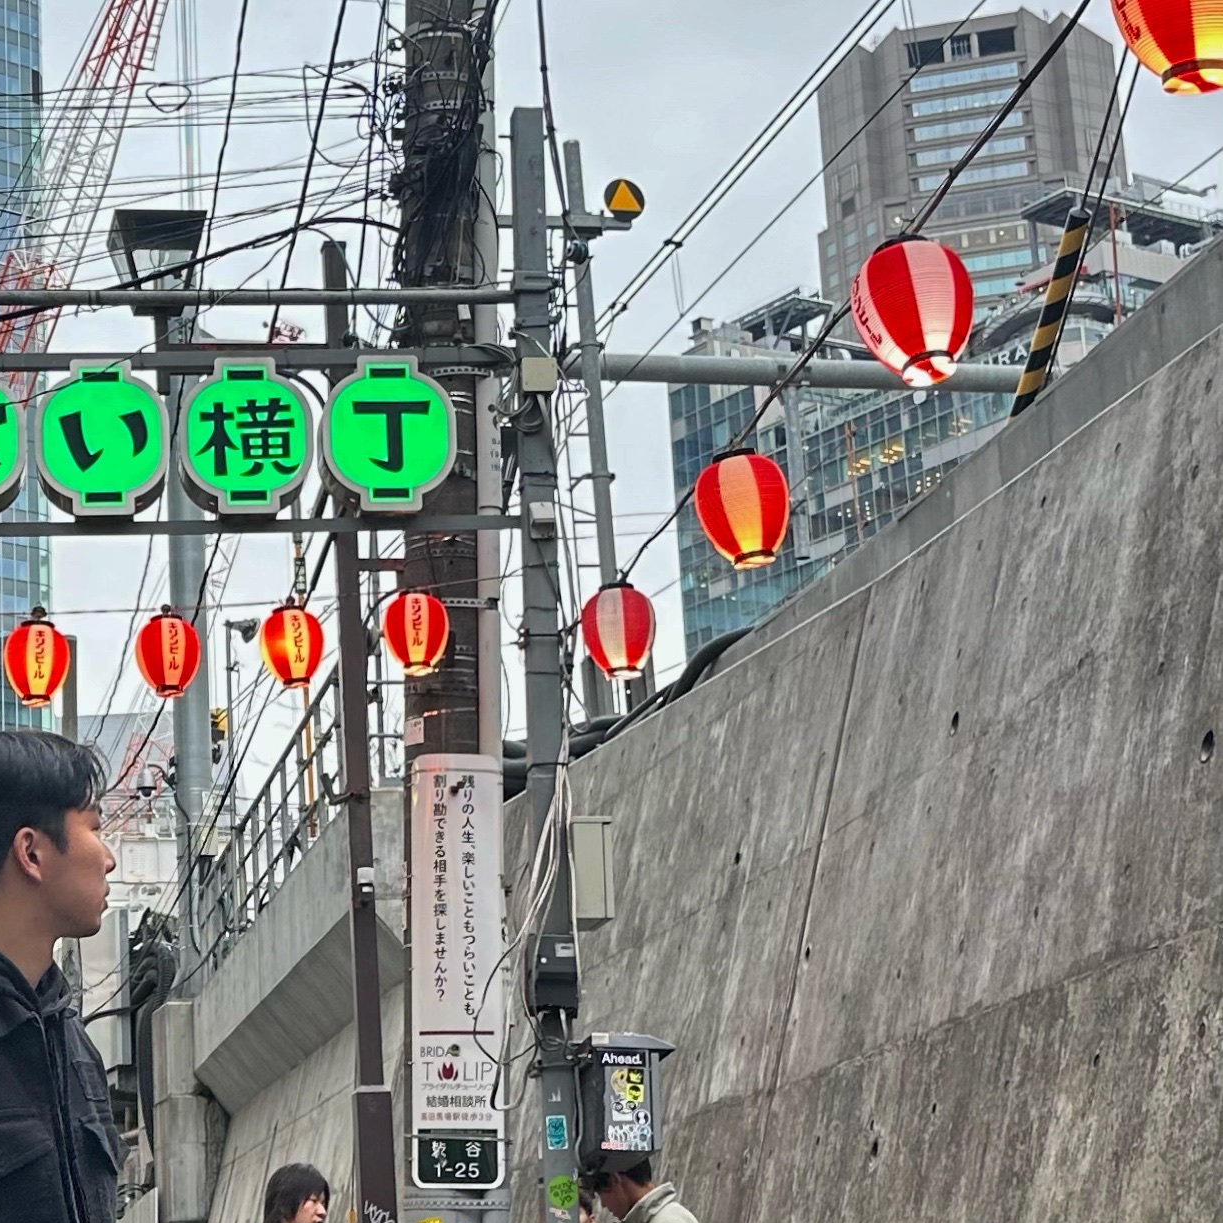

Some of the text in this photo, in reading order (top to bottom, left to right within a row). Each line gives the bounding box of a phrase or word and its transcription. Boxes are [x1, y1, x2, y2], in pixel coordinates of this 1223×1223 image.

[168, 622, 180, 670] キリンビール
[290, 615, 306, 664] キリンビール
[411, 598, 423, 647] キリンビール
[33, 630, 46, 680] キリンビール
[426, 1095, 487, 1108] 結婚相談所
[434, 1162, 480, 1178] 1-25
